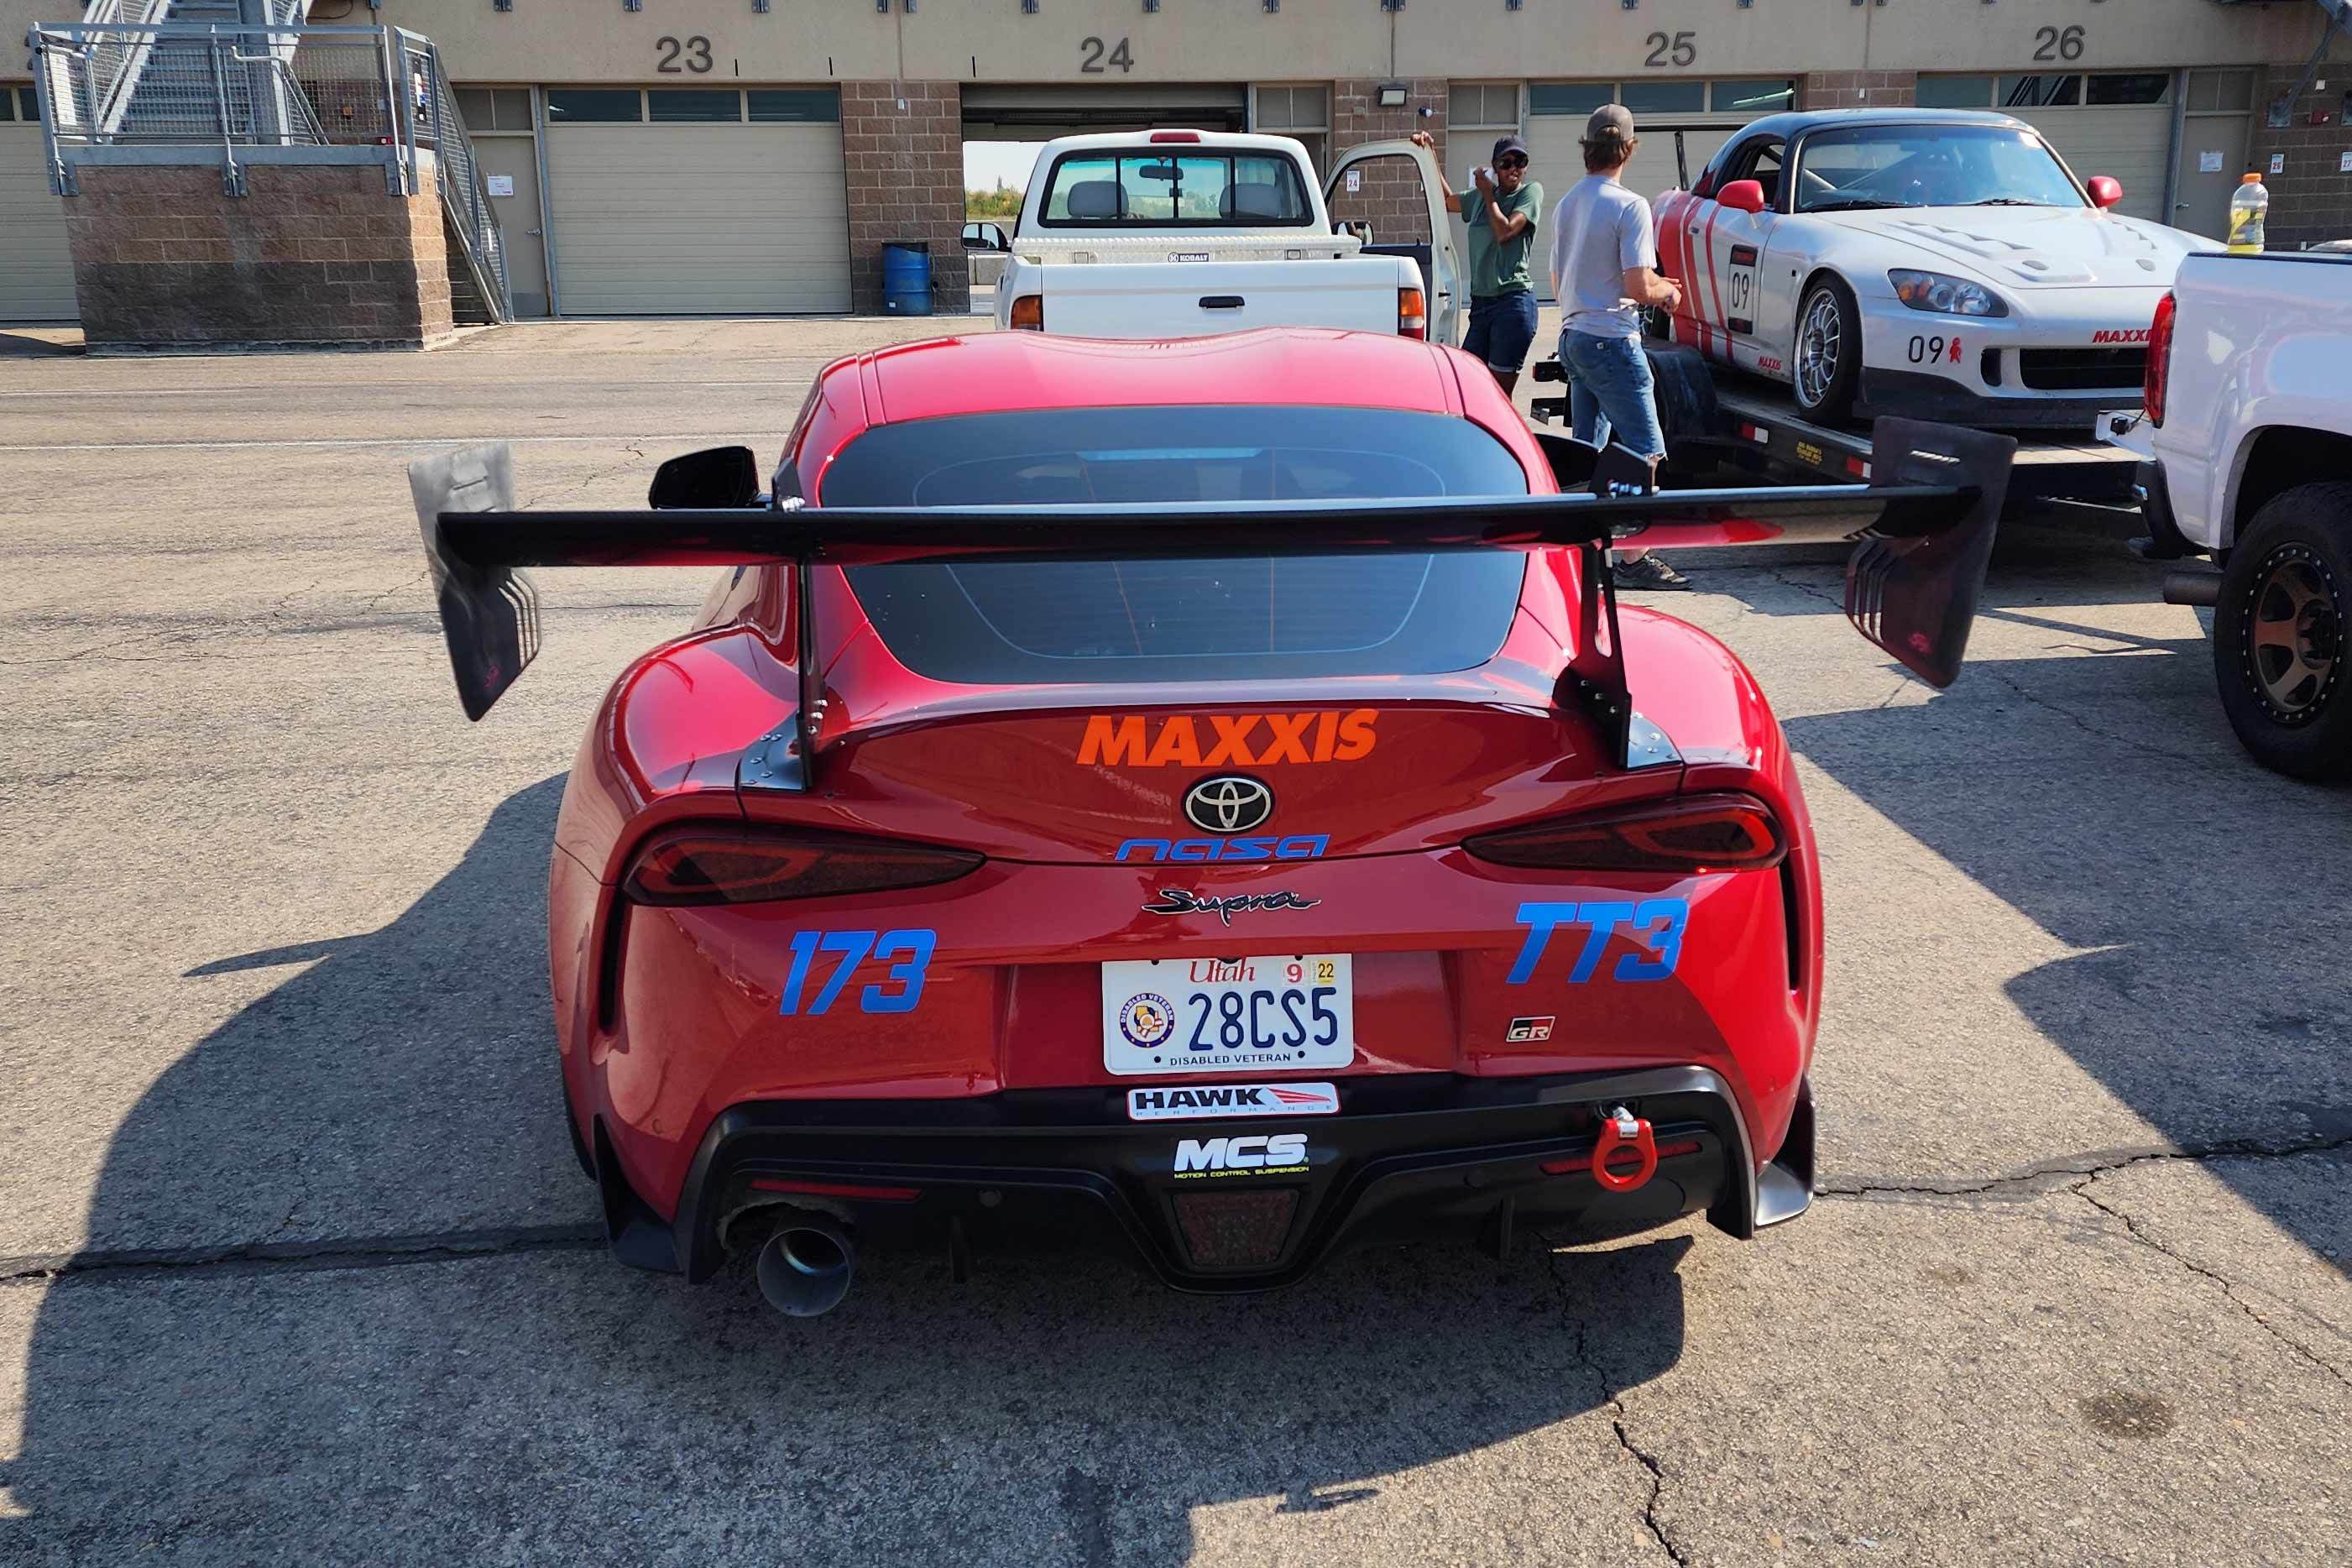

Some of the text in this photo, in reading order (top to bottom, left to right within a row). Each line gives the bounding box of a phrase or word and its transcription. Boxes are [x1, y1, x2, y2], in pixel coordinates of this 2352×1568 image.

[656, 35, 713, 73] 23
[1081, 36, 1134, 72] 24
[1644, 31, 1696, 66] 25
[2033, 24, 2086, 60] 26
[2272, 161, 2281, 170] 26
[1348, 179, 1358, 187] 24
[1732, 271, 1750, 310] 09
[1908, 335, 1944, 363] 09
[2092, 328, 2152, 343] MAXXI
[1759, 355, 1782, 371] MAXXIS
[1075, 708, 1380, 767] MAXXIS
[1141, 888, 1322, 928] Supra
[1505, 897, 1690, 984] TT3
[779, 928, 937, 1015] 173
[1189, 957, 1256, 984] Utah
[1287, 963, 1303, 983] 9
[1318, 963, 1335, 978] 22
[1121, 994, 1174, 1023] DISABLED VETERAN
[1188, 986, 1339, 1052] 28CS5
[1509, 1026, 1550, 1039] GR
[1170, 1053, 1291, 1066] DISABLED VETERAN
[1135, 1088, 1266, 1110] HAWK
[1136, 1105, 1332, 1116] PERFORMANCE
[1173, 1133, 1309, 1171] MCS
[1210, 1169, 1251, 1178] CONTROL
[1255, 1167, 1309, 1175] SUSPENSION
